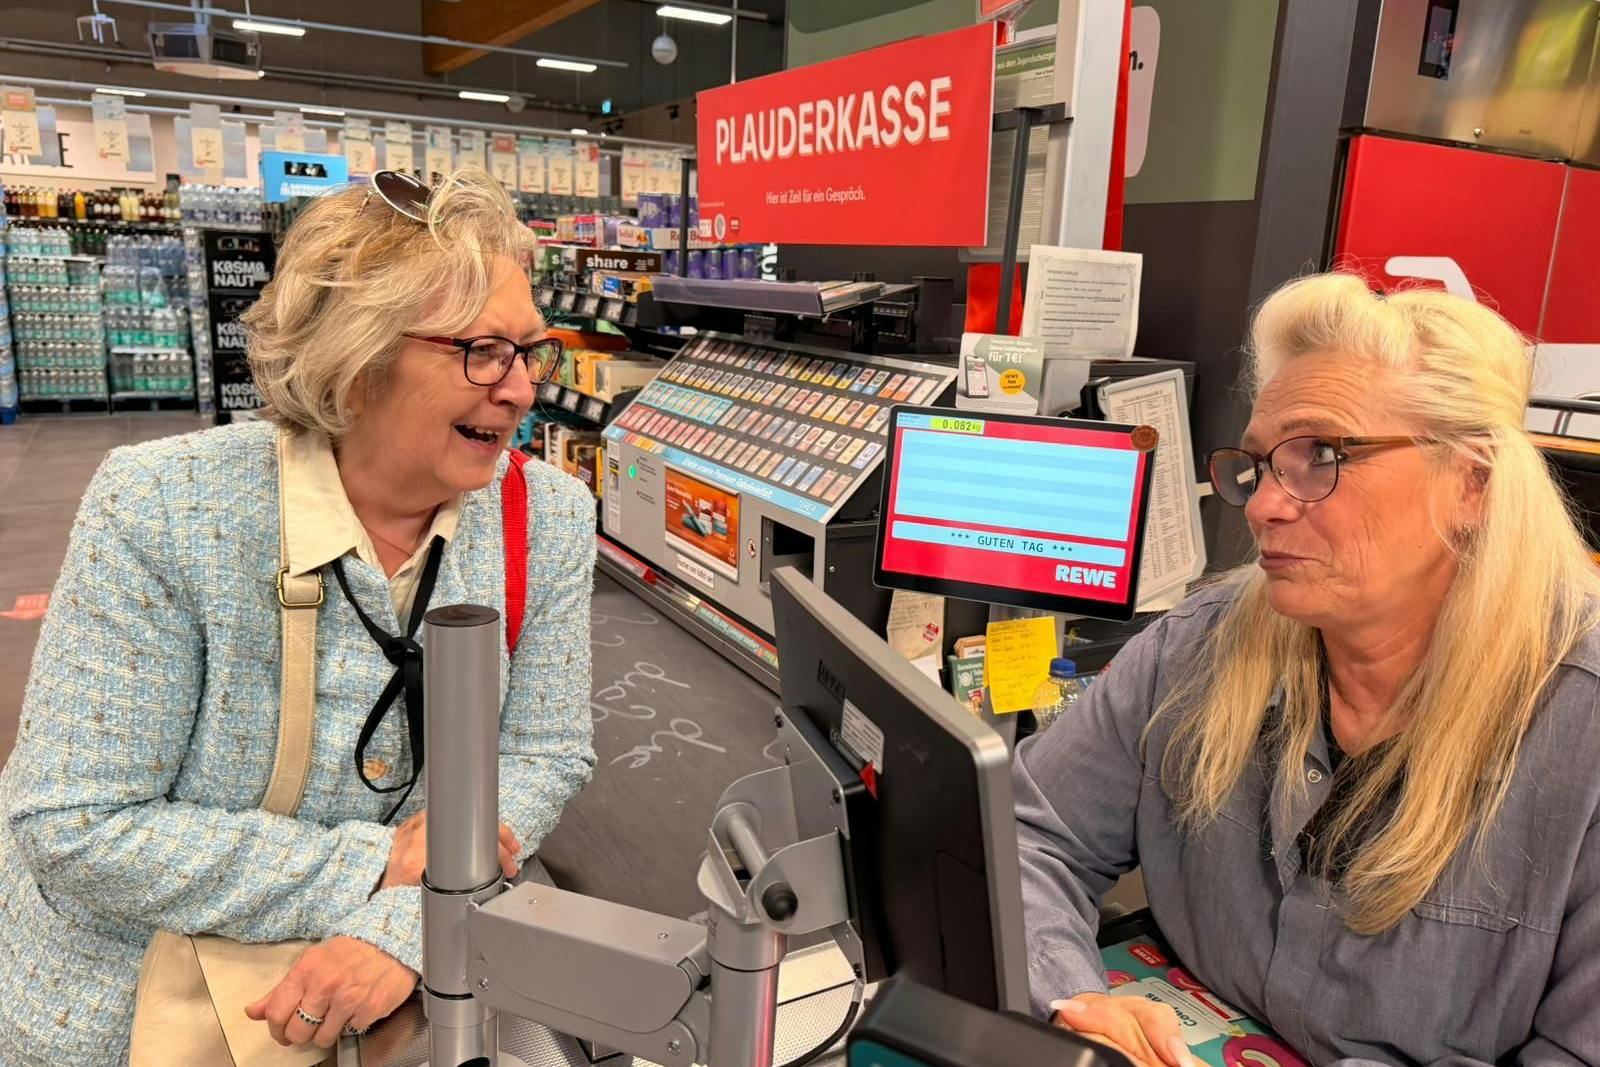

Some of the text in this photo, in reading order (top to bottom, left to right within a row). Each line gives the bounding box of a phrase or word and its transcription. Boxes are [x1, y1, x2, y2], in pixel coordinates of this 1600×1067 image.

[715, 76, 952, 166] PLAUDERKASSE
[765, 184, 866, 205] Hier ist Zeit für ein Gespräch.
[586, 254, 629, 270] share
[213, 273, 256, 288] NAUT
[988, 351, 1004, 363] für
[977, 535, 1044, 553] GUTEN TAG
[1055, 564, 1117, 589] REWE
[1144, 992, 1198, 1027] Couns
